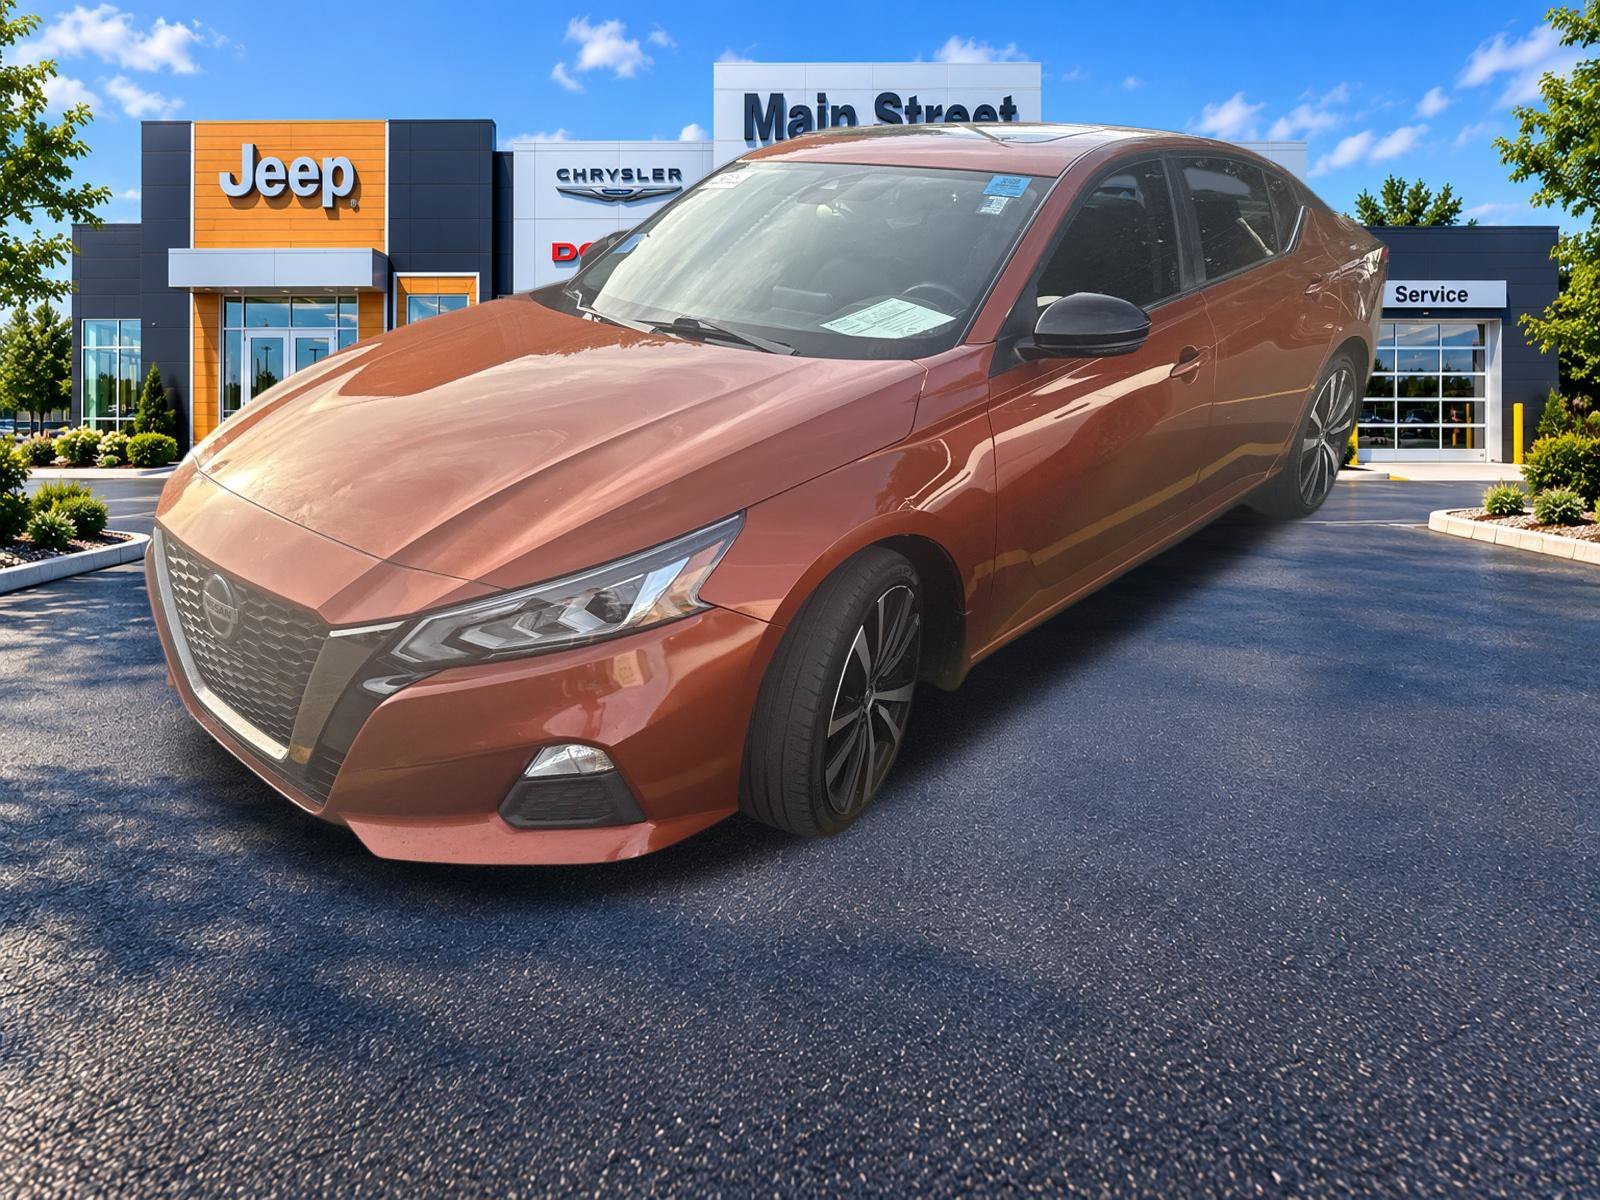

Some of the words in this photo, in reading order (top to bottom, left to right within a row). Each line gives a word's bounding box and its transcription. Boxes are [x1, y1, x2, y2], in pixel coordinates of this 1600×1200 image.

[744, 92, 856, 140] Main
[218, 143, 356, 208] Jeep
[556, 168, 682, 182] CHRYSLER
[1395, 285, 1469, 303] Service
